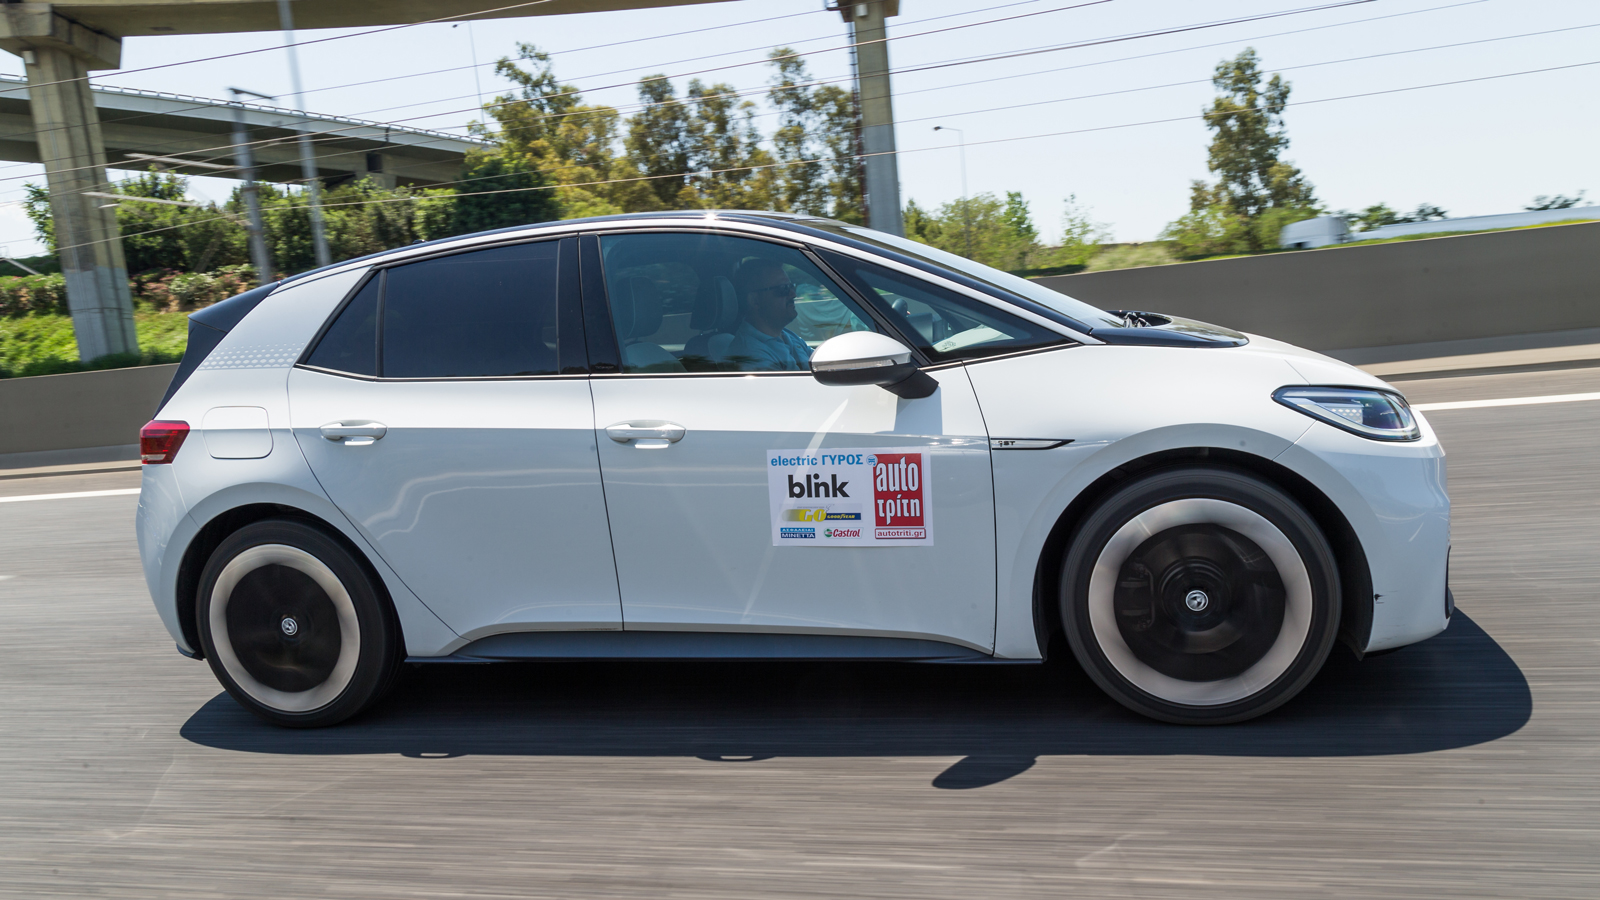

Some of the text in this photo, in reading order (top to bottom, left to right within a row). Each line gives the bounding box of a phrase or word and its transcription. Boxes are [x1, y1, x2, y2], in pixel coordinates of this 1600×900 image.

[771, 454, 864, 466] electric ΓΥΡΟΣ
[876, 456, 919, 492] auto
[788, 473, 850, 498] blink
[798, 508, 827, 522] GO
[877, 494, 920, 525] τρίτη
[833, 529, 860, 537] Castrol
[877, 530, 923, 538] autotriti.gr
